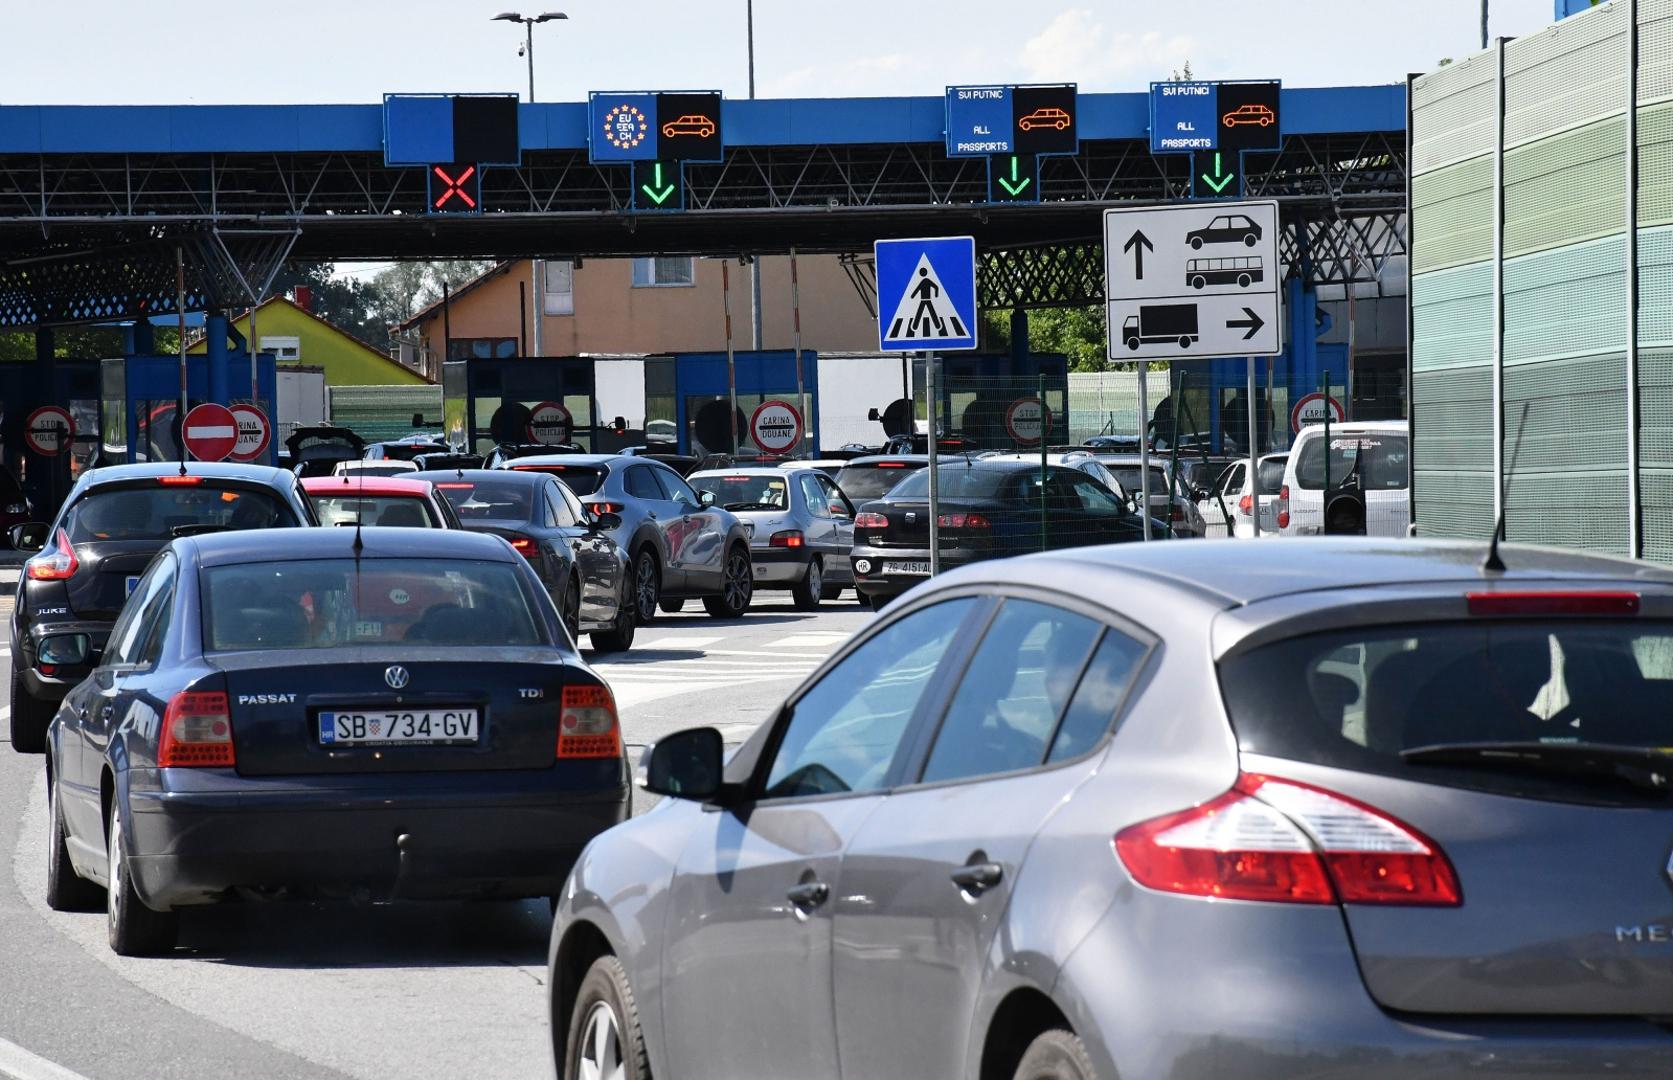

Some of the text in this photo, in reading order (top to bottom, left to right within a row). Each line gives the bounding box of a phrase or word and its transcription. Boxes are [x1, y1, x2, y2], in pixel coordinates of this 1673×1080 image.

[958, 91, 971, 99] SVI
[1162, 86, 1209, 96] SVI PUTNICI
[619, 114, 632, 123] EU
[973, 125, 991, 135] ALL
[1177, 121, 1195, 131] ALL
[619, 132, 632, 140] CH
[957, 142, 1008, 152] PASSPORTS
[1161, 138, 1211, 148] PASSPORTS
[40, 420, 56, 429] STO
[763, 416, 790, 425] CARINA
[238, 421, 257, 430] RINA
[762, 430, 792, 439] DOUANE
[858, 561, 869, 572] HR
[36, 607, 67, 616] JUKE
[238, 693, 297, 705] PASSAT
[338, 712, 472, 739] SB 734-GV
[322, 731, 335, 739] HR
[1615, 925, 1673, 942] ME
